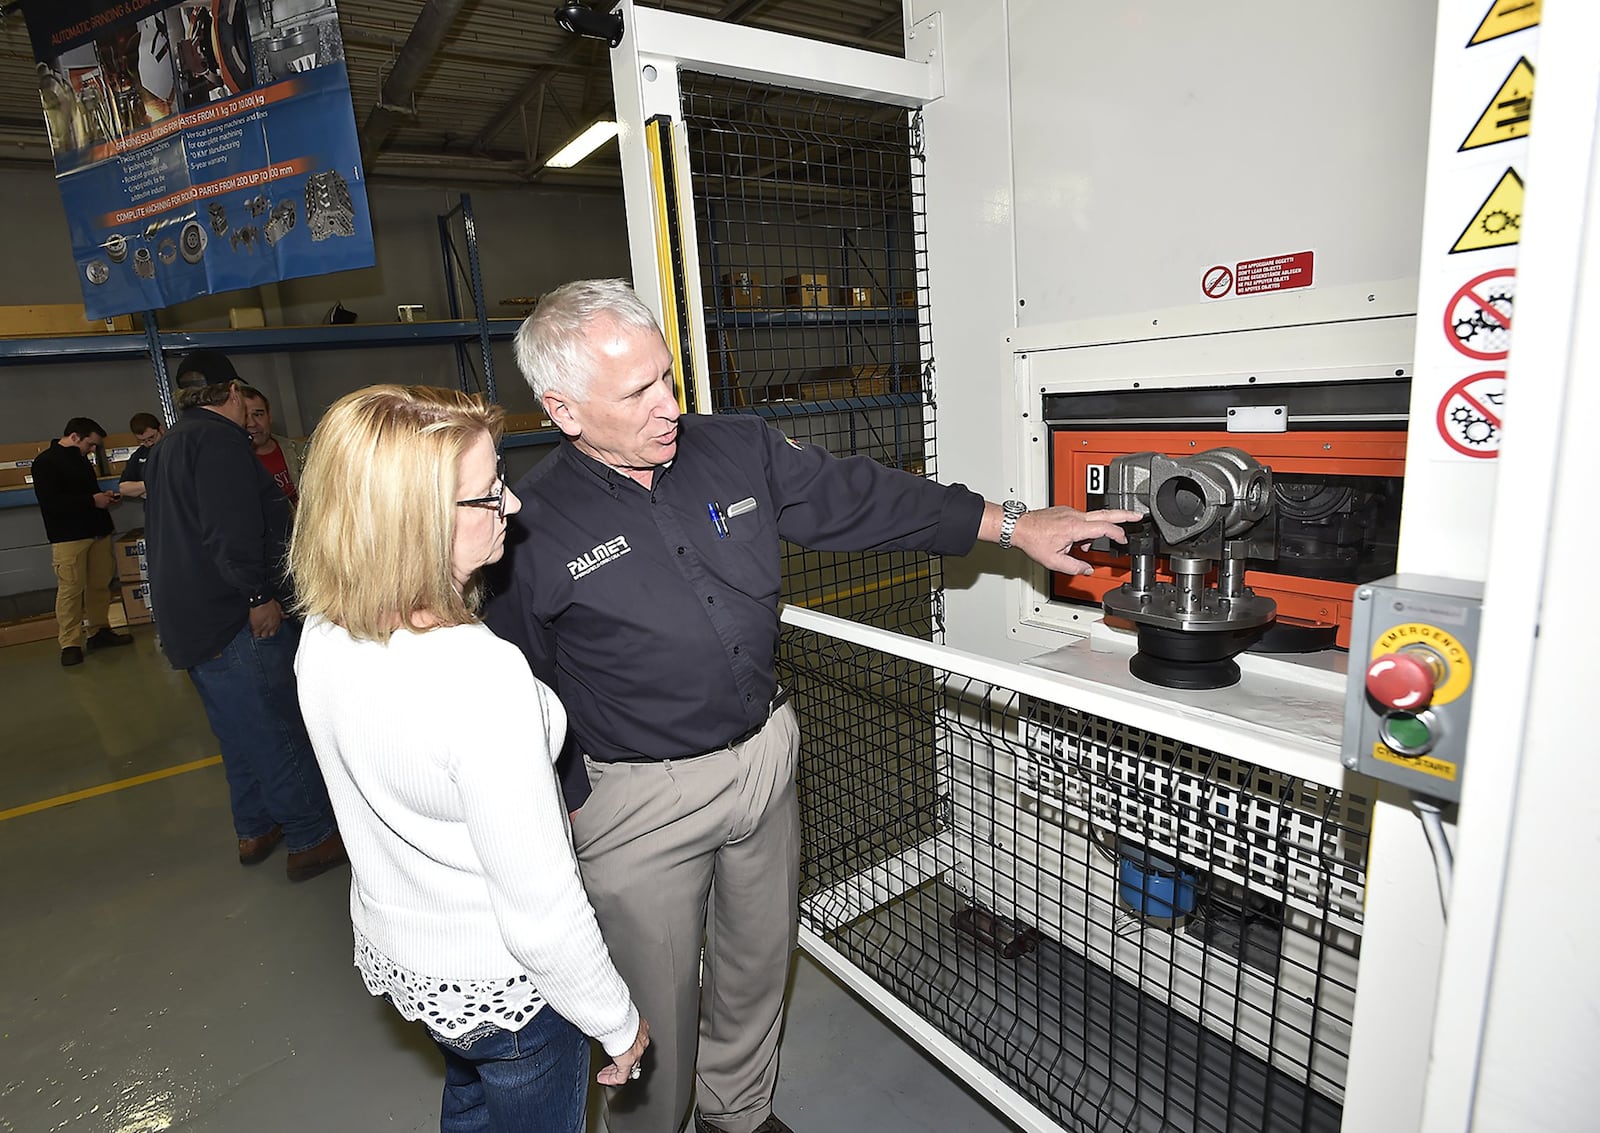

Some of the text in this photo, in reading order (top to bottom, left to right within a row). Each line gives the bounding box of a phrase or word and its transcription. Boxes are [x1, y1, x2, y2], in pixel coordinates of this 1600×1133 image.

[51, 19, 91, 45] AUTOMATIC
[125, 3, 132, 13] &
[141, 125, 169, 143] SOLUTIONS
[168, 121, 179, 132] FOR
[178, 113, 197, 130] PARTS
[197, 109, 215, 122] FROM
[215, 107, 220, 117] 1
[220, 106, 229, 117] kg
[229, 103, 238, 113] TO
[254, 94, 265, 107] kg
[185, 129, 207, 140] Vertical
[223, 117, 246, 130] machines
[196, 135, 219, 149] complete
[218, 127, 243, 142] machining
[145, 199, 172, 214] MACHINING
[171, 195, 181, 206] FOR
[198, 183, 219, 197] PARTS
[219, 179, 236, 192] FROM
[236, 175, 249, 187] 200
[248, 173, 259, 184] UP
[259, 171, 268, 181] TO
[269, 167, 279, 178] 00
[279, 165, 293, 176] mm
[1090, 466, 1100, 491] B
[566, 535, 629, 576] PALMER
[1381, 626, 1464, 665] EMERGENCY
